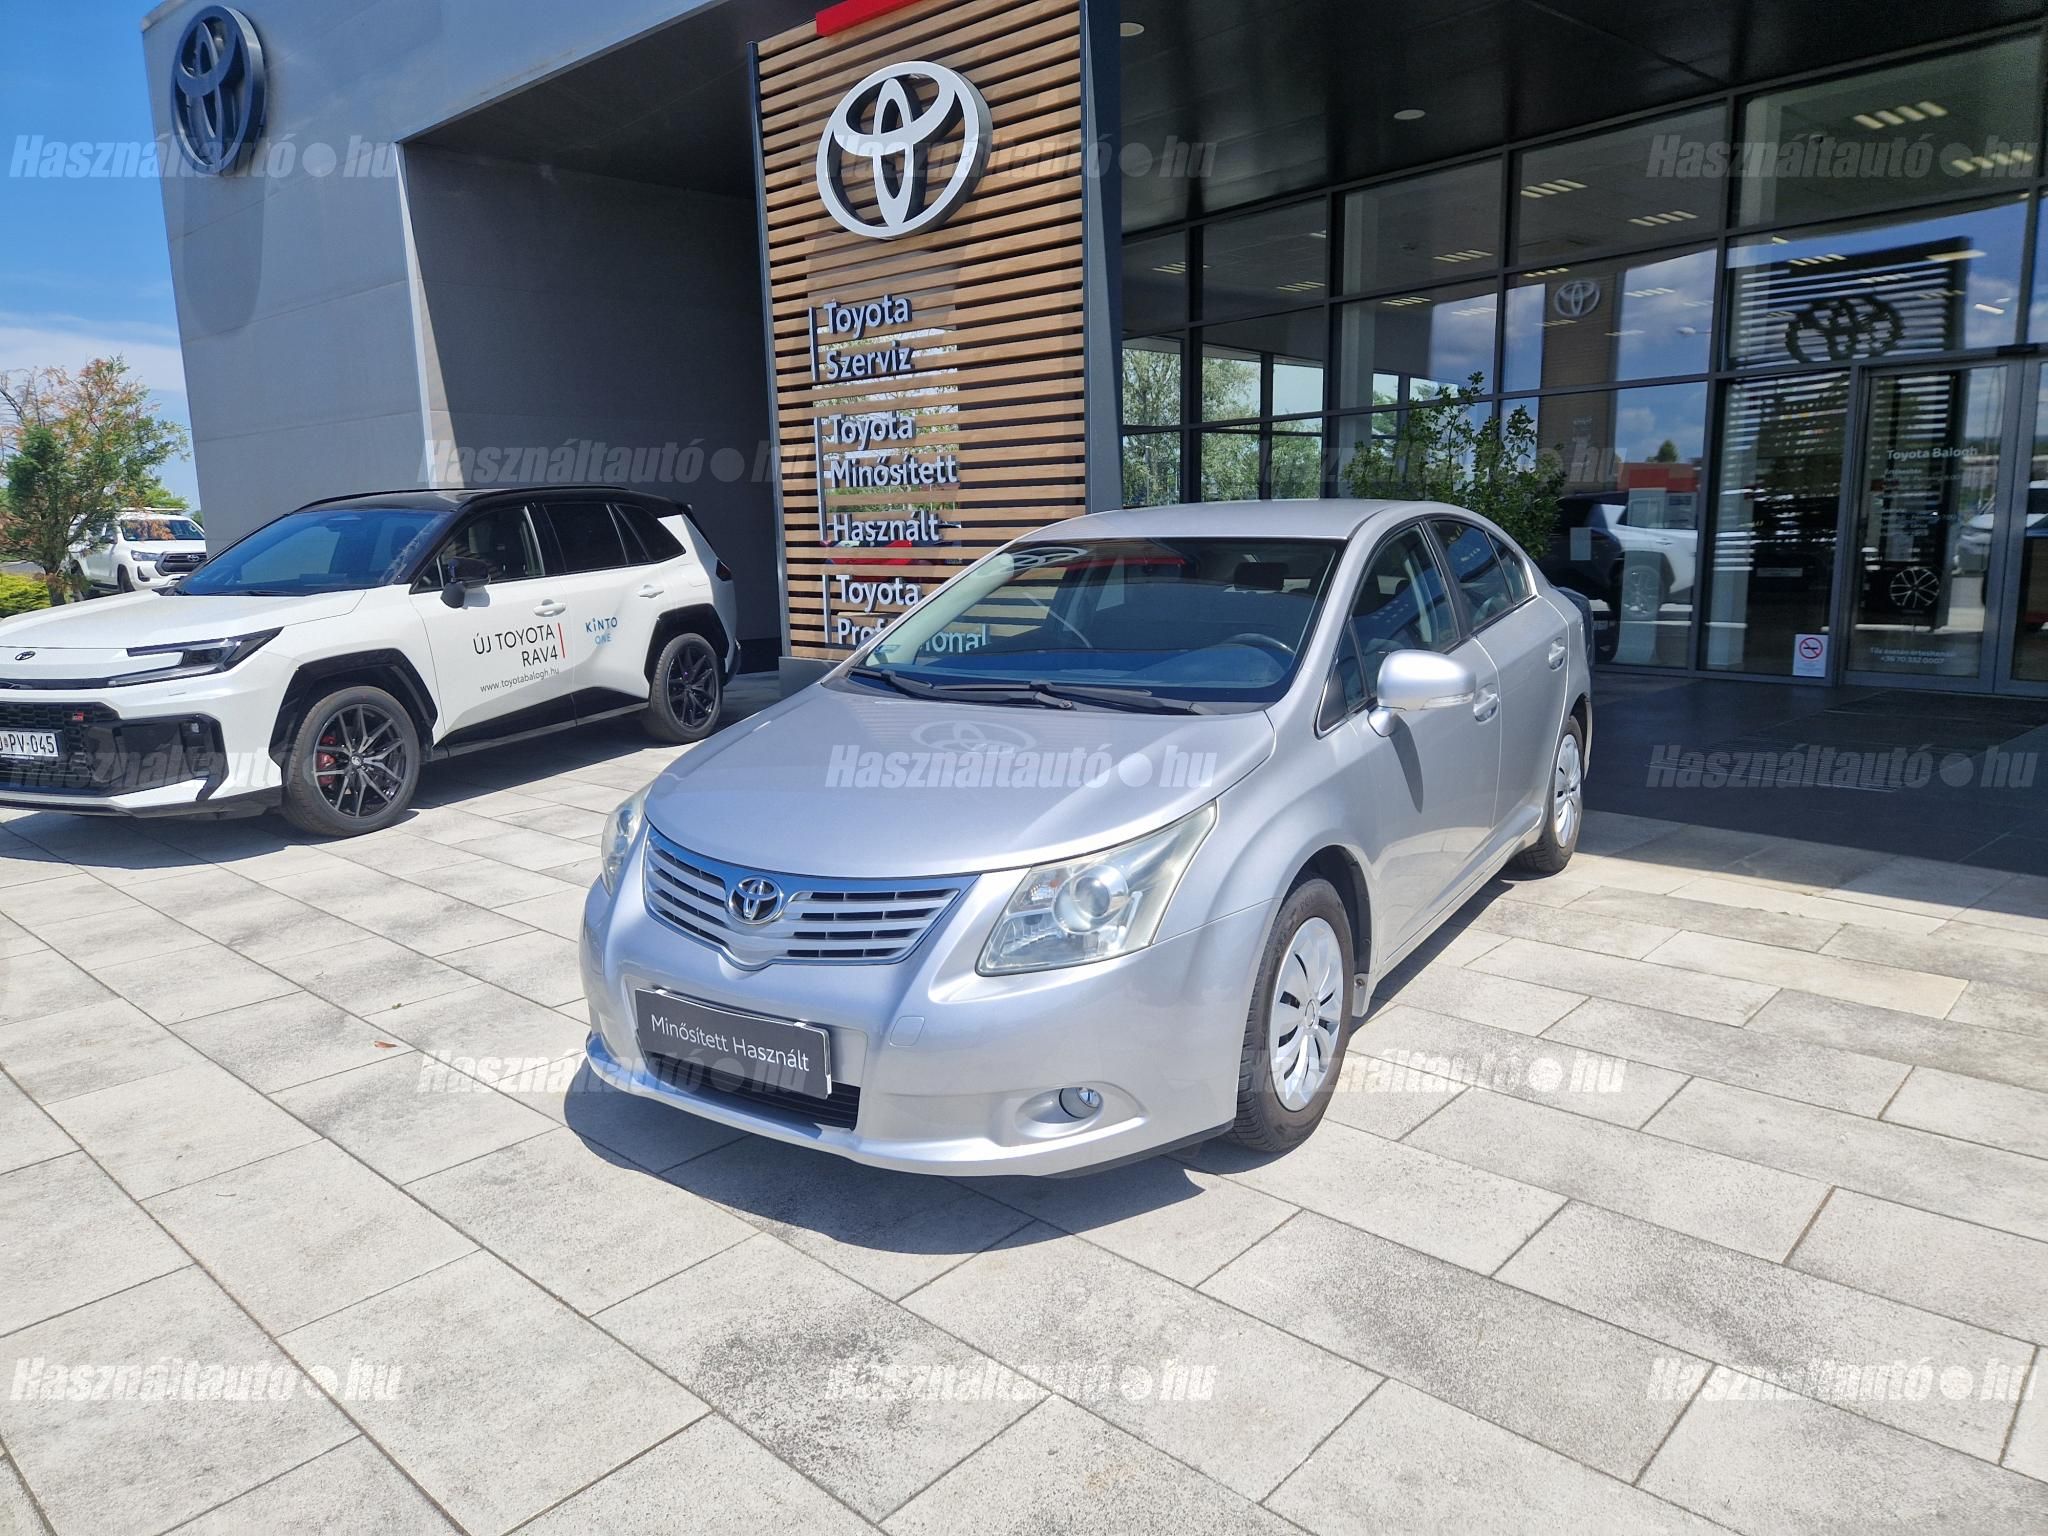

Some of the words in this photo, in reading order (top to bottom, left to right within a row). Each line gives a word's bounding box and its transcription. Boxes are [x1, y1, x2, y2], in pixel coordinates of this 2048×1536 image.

[824, 294, 912, 338] Toyota
[826, 340, 914, 379] Szerviz
[829, 411, 914, 450] Toyota
[830, 454, 959, 487] Minősített
[1887, 449, 1930, 461] Toyota
[833, 510, 941, 542] Használt
[836, 575, 920, 612] Toyota
[472, 632, 491, 655] ÚJ
[494, 624, 556, 650] TOYOTA
[594, 632, 612, 645] ONE
[521, 645, 558, 667] RAV4
[480, 667, 560, 693] www.toyotabalogh.hu
[650, 1013, 729, 1053] Minősített
[732, 1036, 811, 1073] Használt
